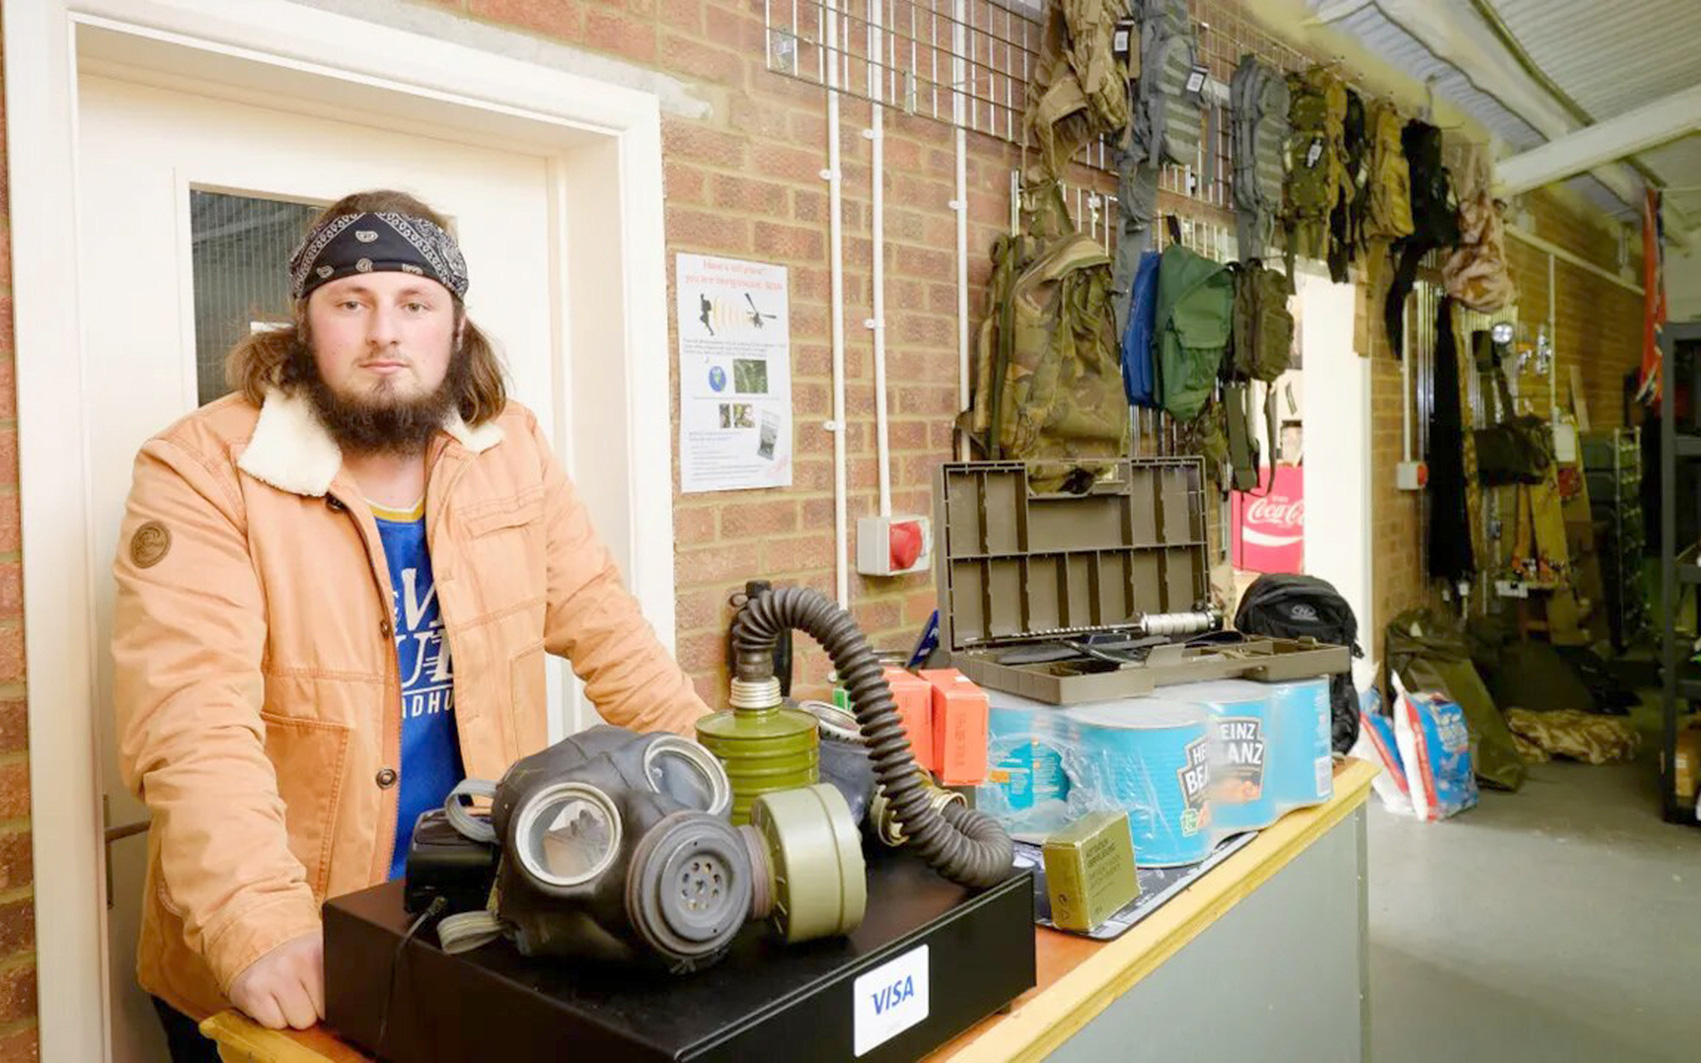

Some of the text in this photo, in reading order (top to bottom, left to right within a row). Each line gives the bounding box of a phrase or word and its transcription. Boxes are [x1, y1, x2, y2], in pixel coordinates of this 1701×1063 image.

[1219, 722, 1256, 740] EINZ
[1227, 742, 1264, 765] ANZ
[871, 974, 914, 1016] VISA
